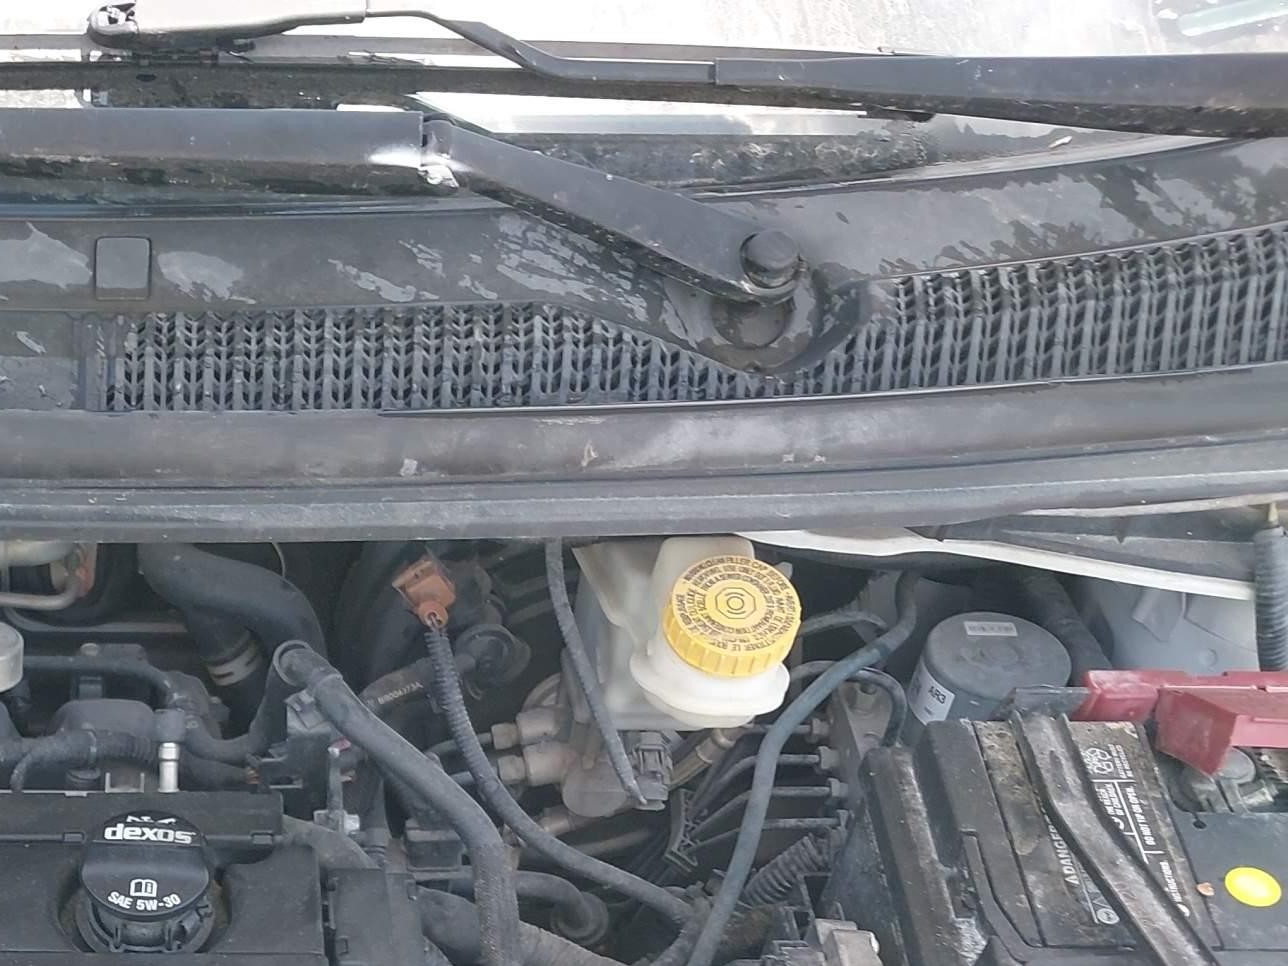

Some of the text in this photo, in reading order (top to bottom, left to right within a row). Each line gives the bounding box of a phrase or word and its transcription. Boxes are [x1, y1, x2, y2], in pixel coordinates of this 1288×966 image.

[104, 823, 197, 844] dexos
[107, 891, 181, 911] SAE 5W-30
